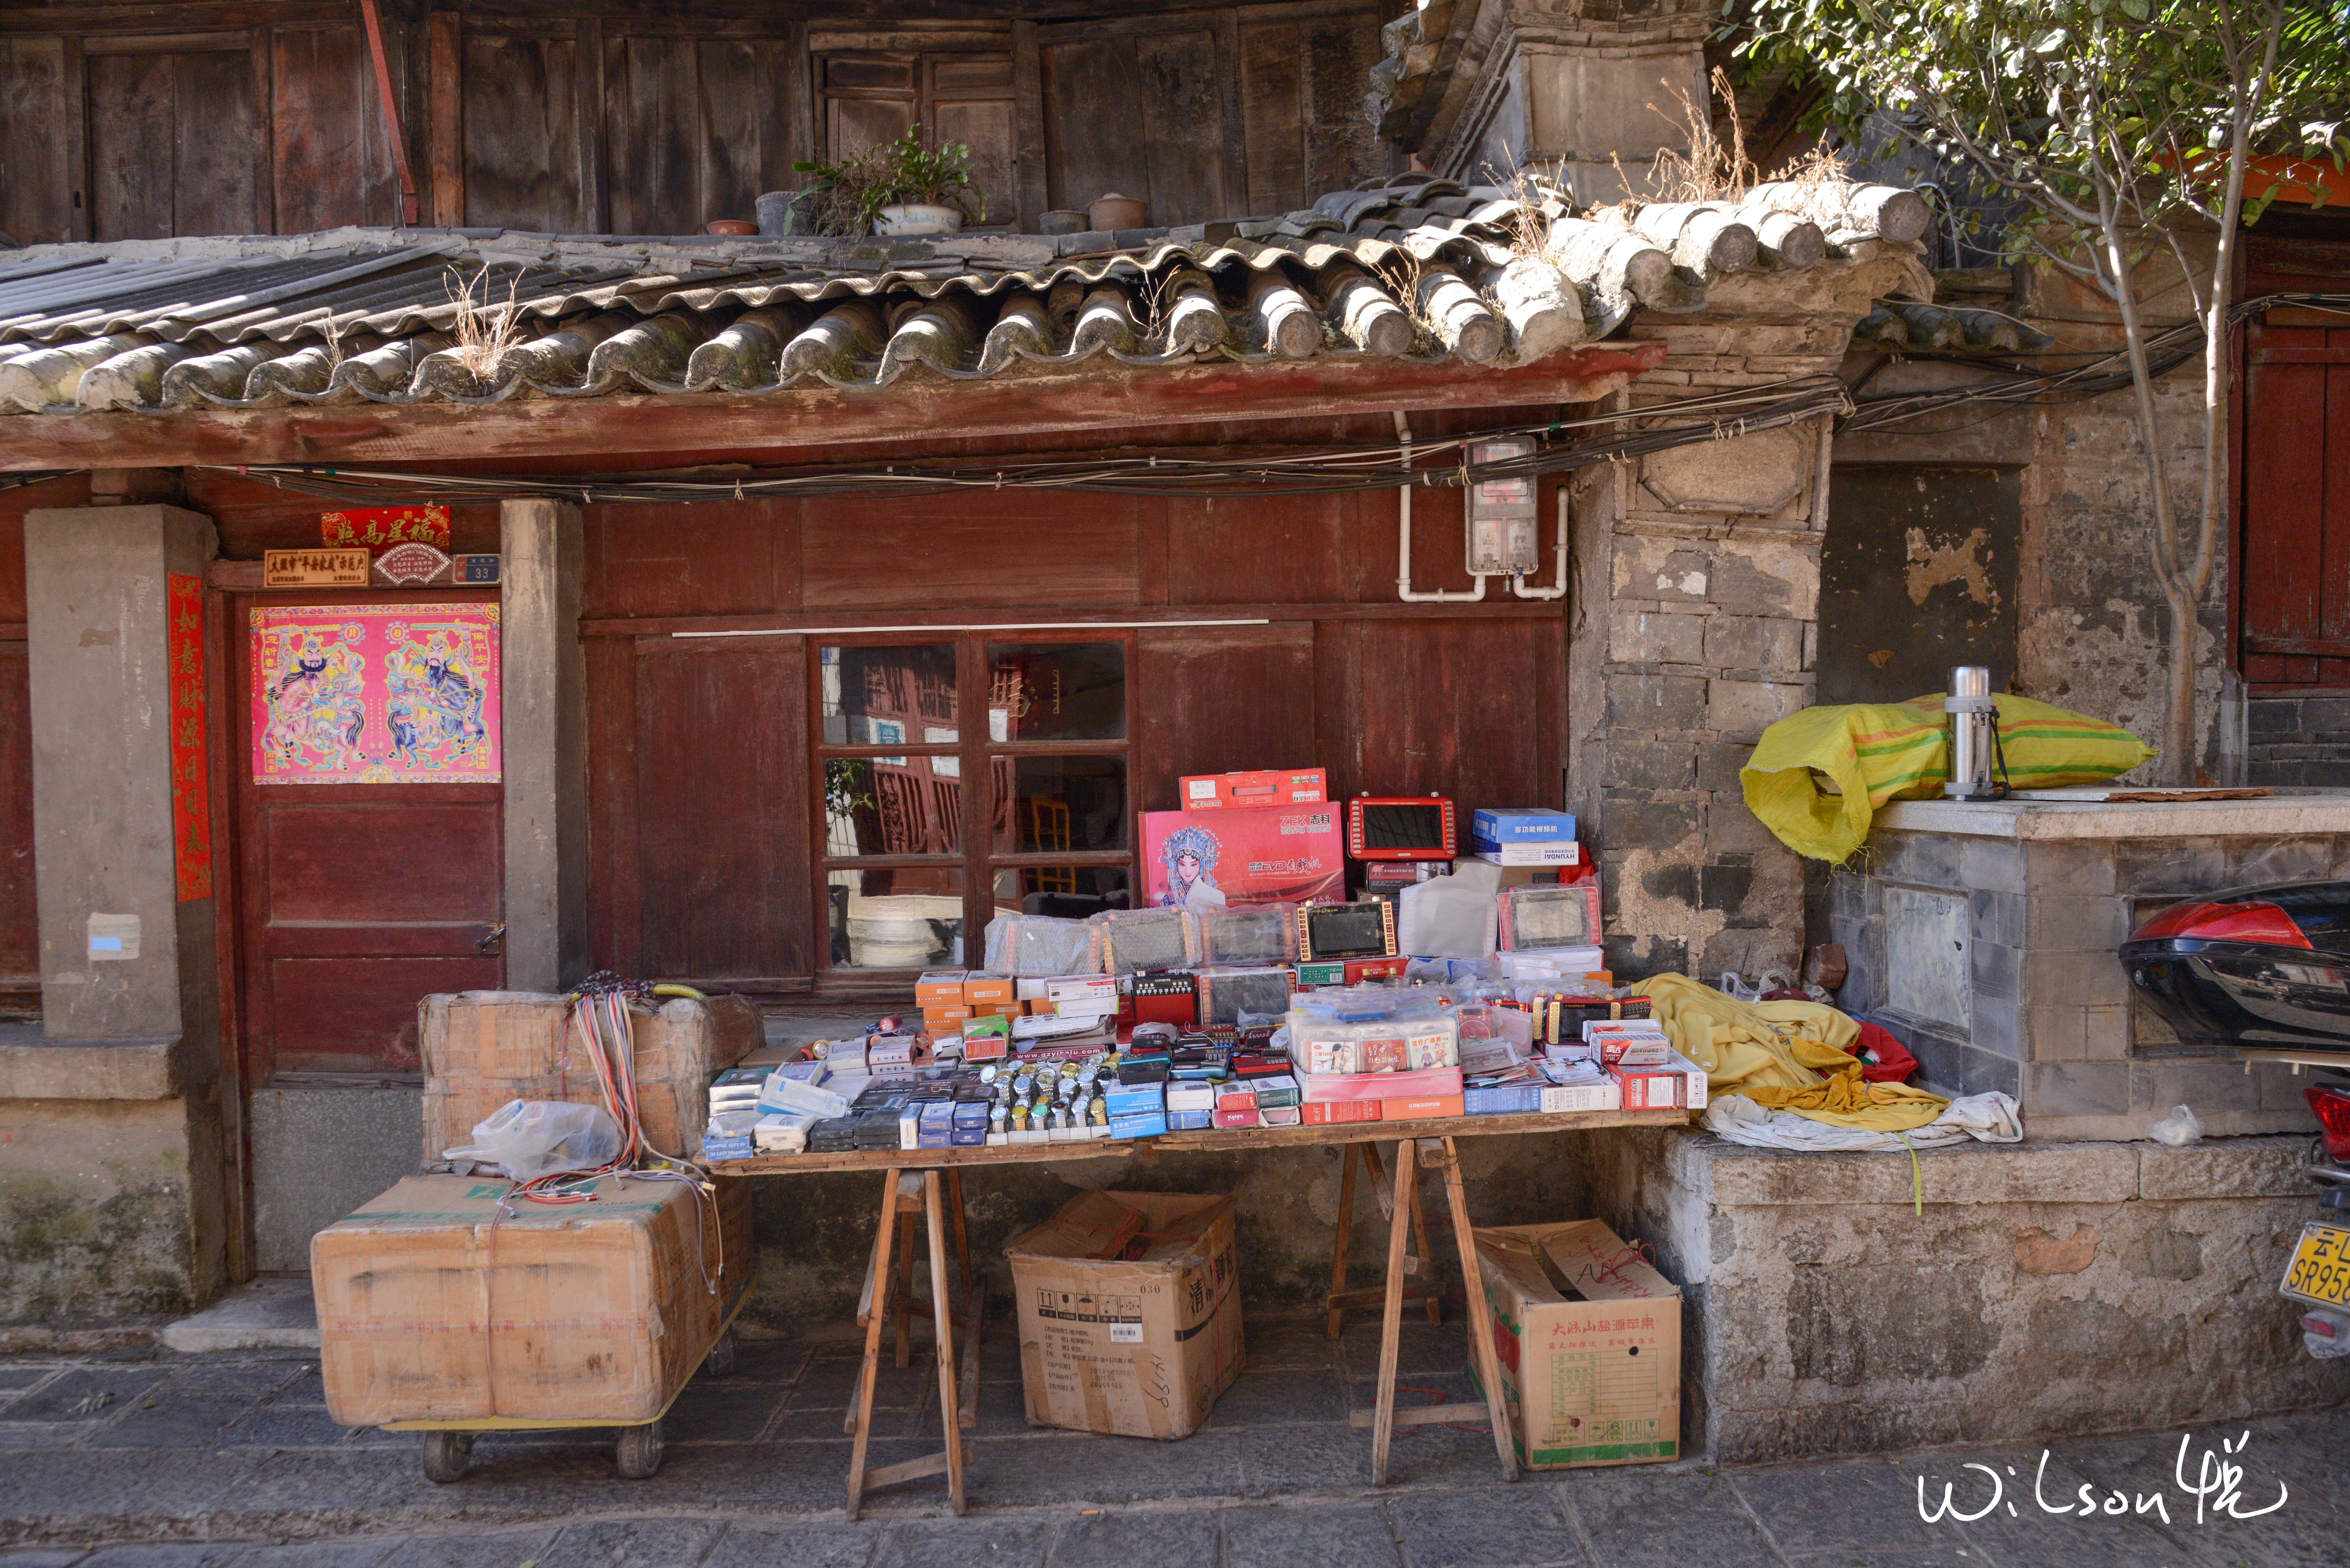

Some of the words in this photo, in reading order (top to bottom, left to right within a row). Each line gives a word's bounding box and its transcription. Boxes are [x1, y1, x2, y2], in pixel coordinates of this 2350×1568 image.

[476, 569, 488, 578] 33
[349, 629, 356, 638] 月
[394, 628, 402, 637] 日
[265, 636, 279, 668] 迎新春
[472, 632, 488, 664] 保平安
[1280, 815, 1307, 827] ZEK
[1310, 813, 1331, 824] 志科
[1606, 1045, 1623, 1054] 雷达
[1140, 1285, 1160, 1293] 030
[1552, 1317, 1654, 1336] 大凉山盐源苹果
[1549, 1340, 1597, 1350] 离太阳很近
